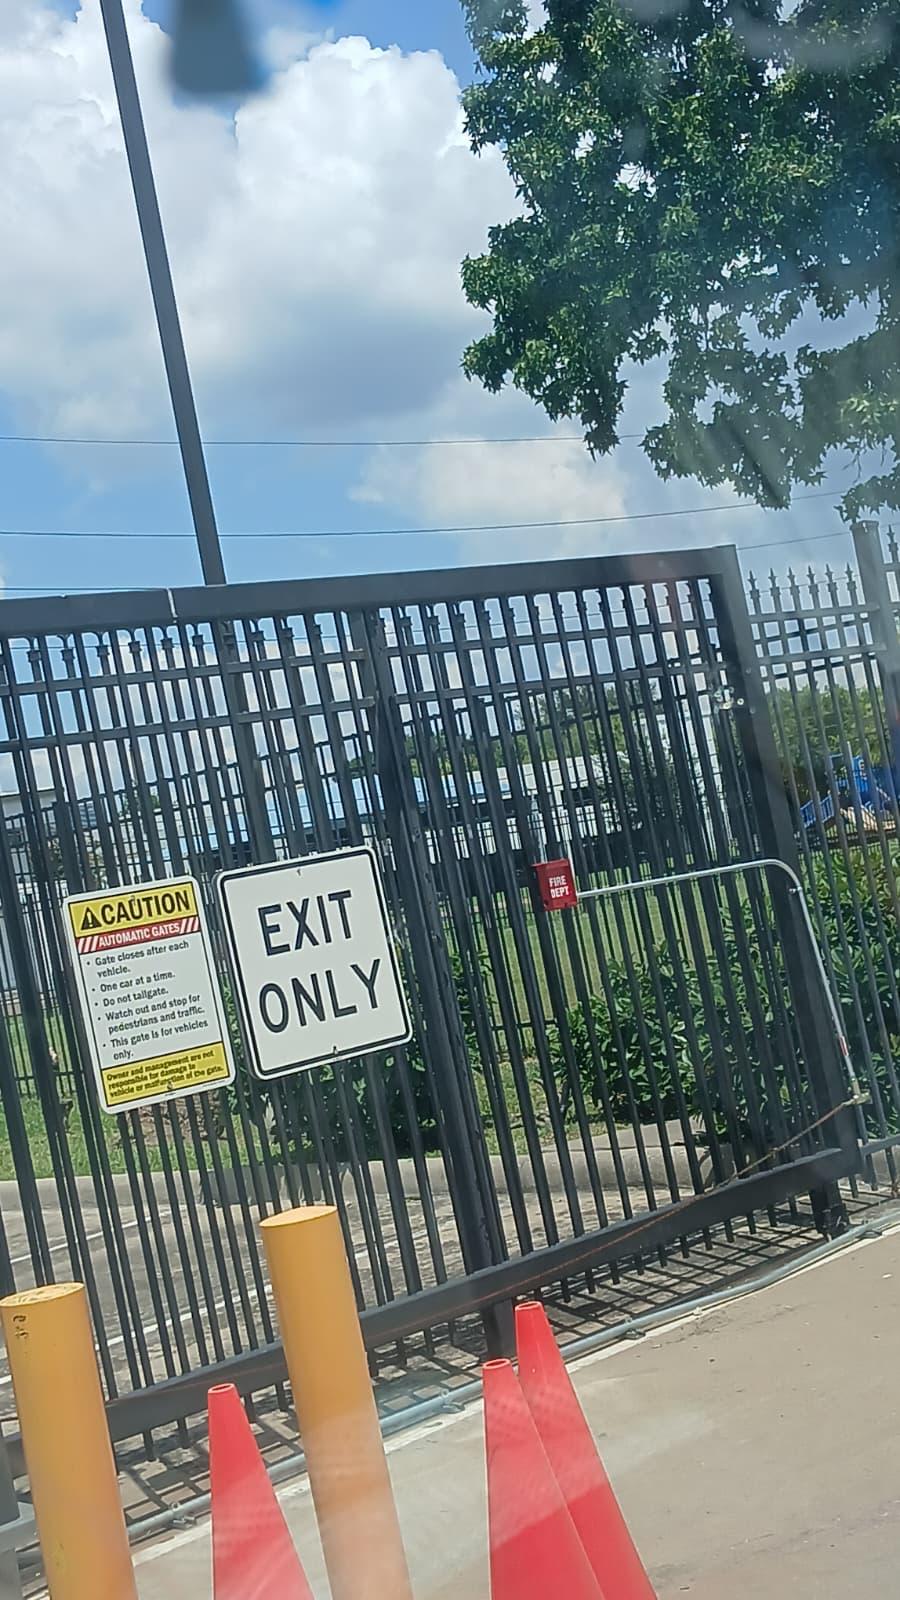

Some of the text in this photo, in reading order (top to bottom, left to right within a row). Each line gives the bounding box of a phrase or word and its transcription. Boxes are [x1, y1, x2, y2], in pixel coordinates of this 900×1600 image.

[549, 875, 567, 887] FIRE
[550, 886, 569, 898] DEPT
[101, 889, 191, 925] CAUTION
[99, 922, 180, 948] AUTOMATIC GATES
[257, 890, 351, 956] EXIT
[95, 940, 189, 966] Gate closes after each
[97, 965, 131, 978] vehicle.
[100, 971, 176, 993] One car at a time.
[103, 987, 169, 1007] Do not tailgate.
[105, 994, 201, 1021] Watch out and stop for
[258, 958, 380, 1033] ONLY
[108, 1006, 205, 1035] pedestrians and traffic.
[110, 1019, 208, 1048] This gate is for vehicles
[107, 1050, 214, 1081] Owner and management are not
[113, 1049, 134, 1060] only.
[149, 1071, 159, 1079] for
[160, 1066, 187, 1079] damage
